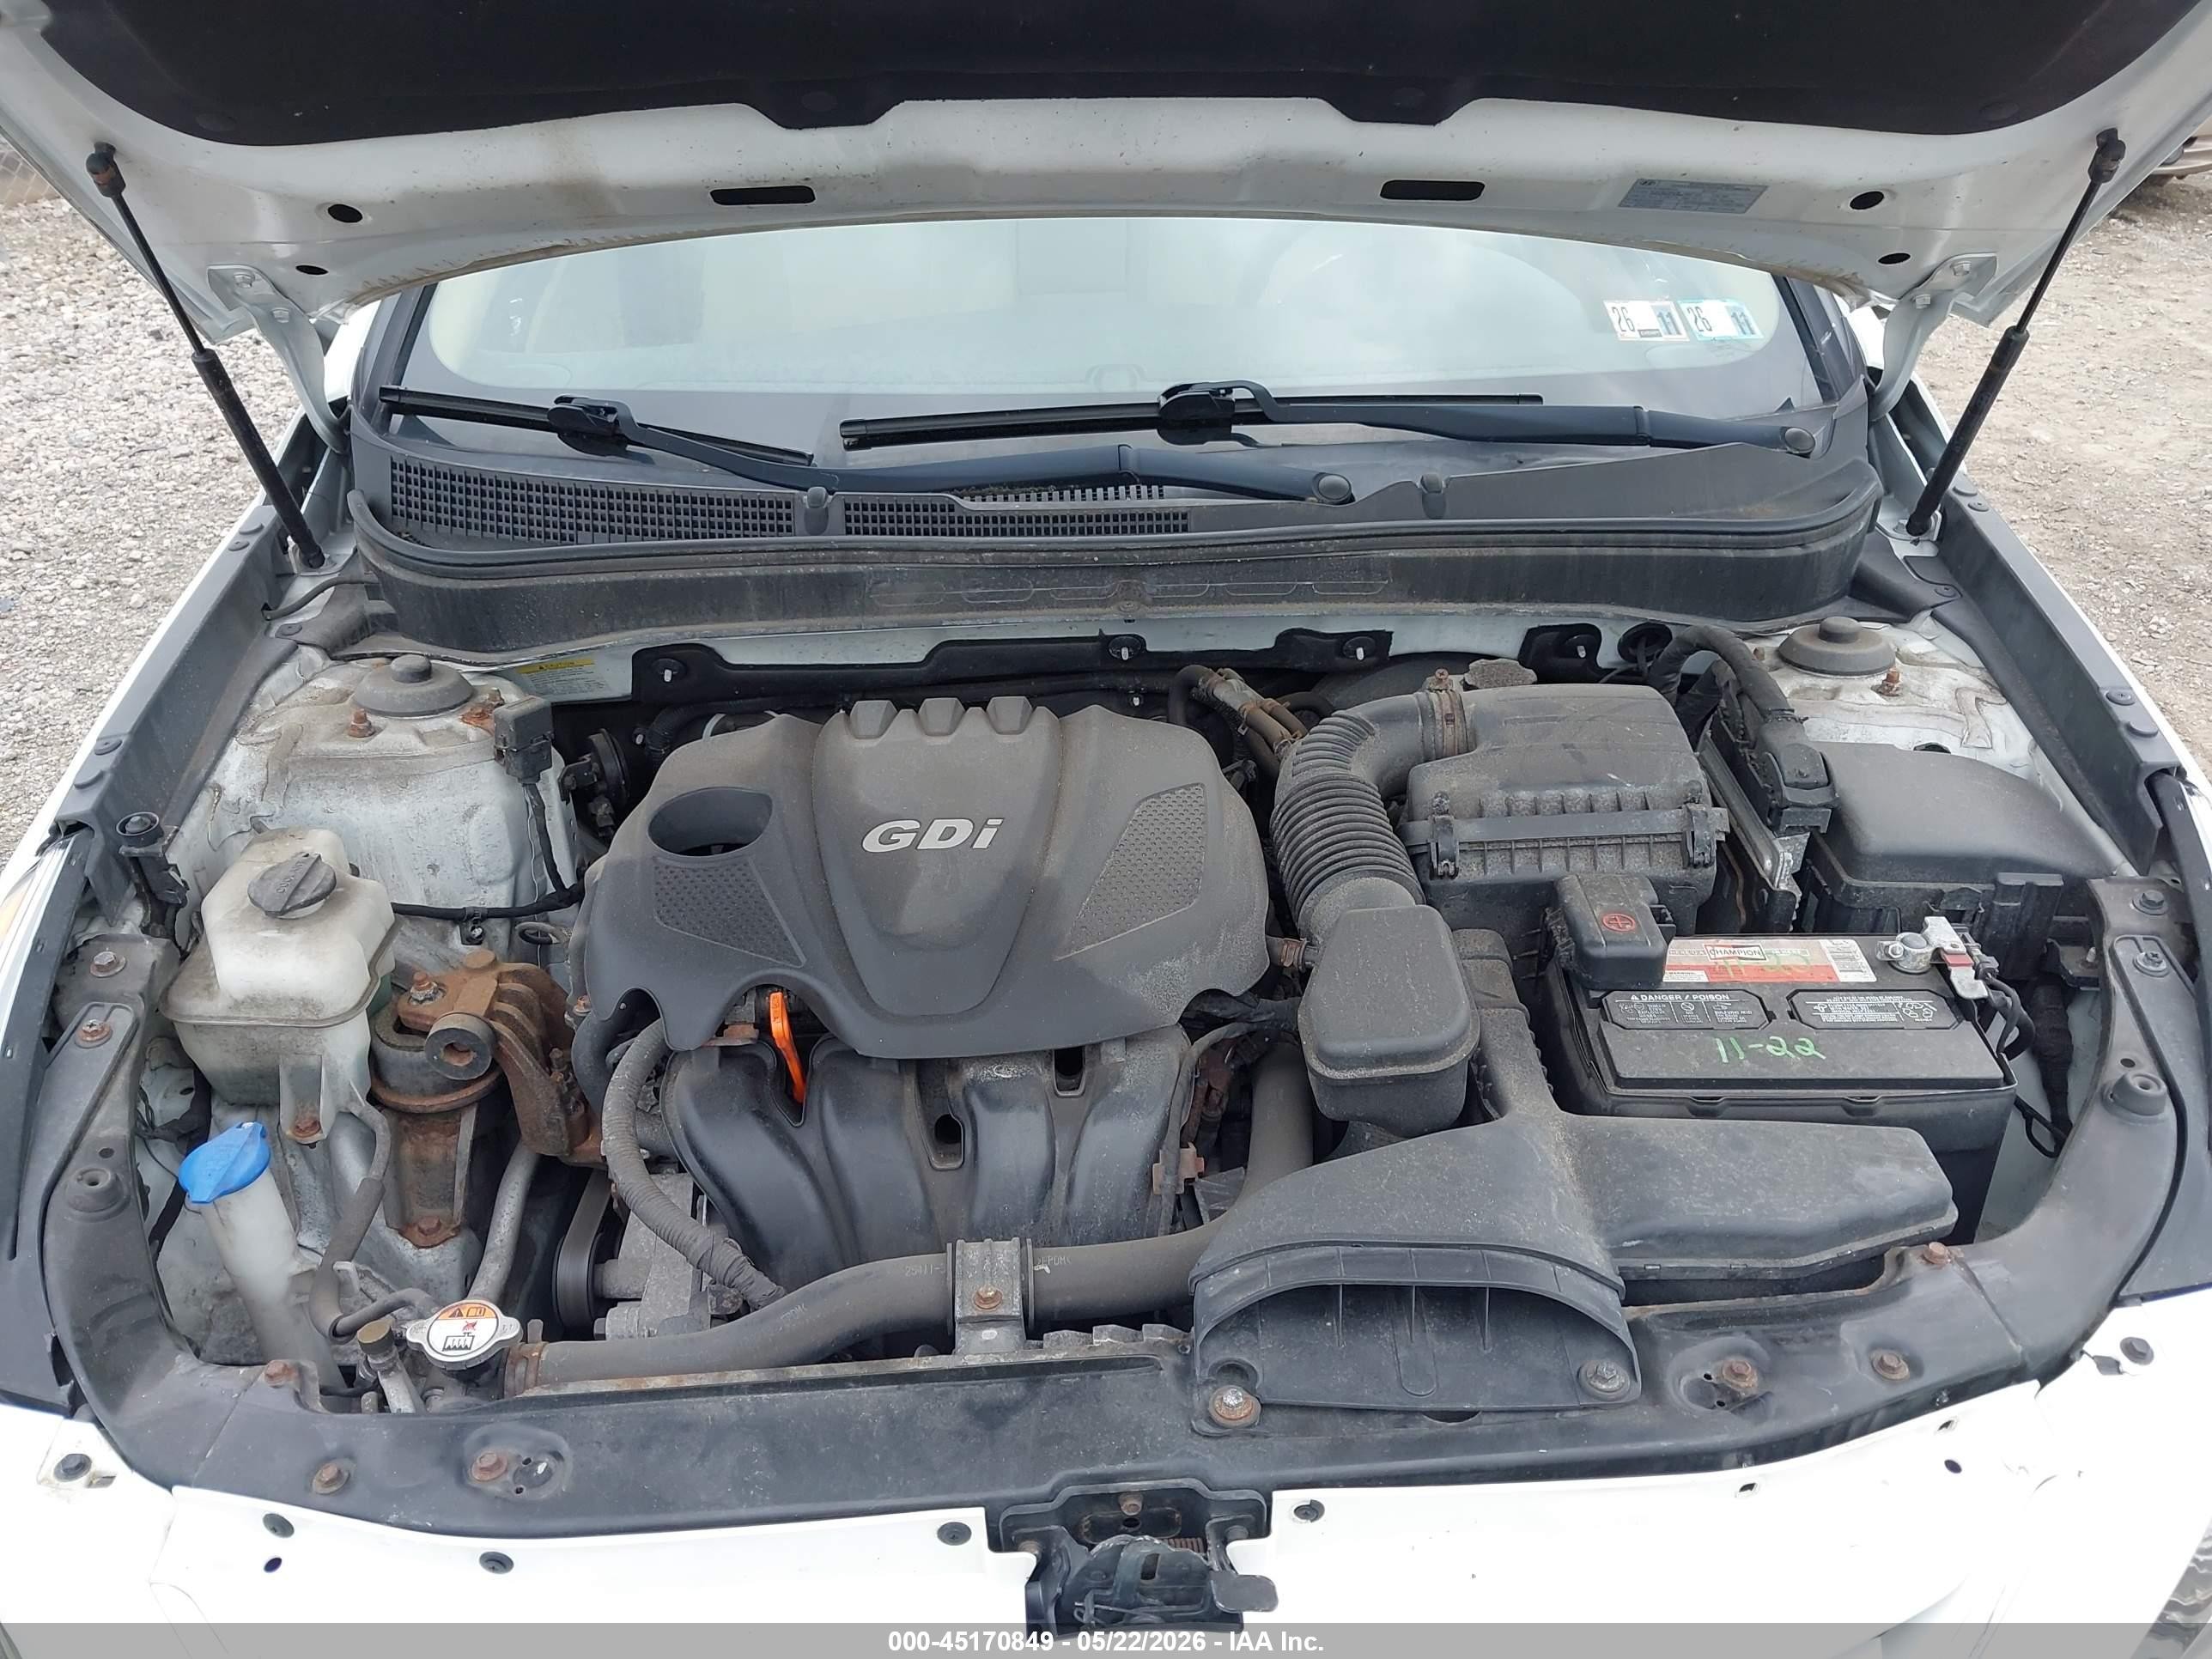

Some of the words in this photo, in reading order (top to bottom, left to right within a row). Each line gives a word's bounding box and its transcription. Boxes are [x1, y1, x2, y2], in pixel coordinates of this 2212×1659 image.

[1611, 306, 1635, 332] 26
[1657, 312, 1682, 335] 11
[1686, 306, 1712, 332] 26
[1730, 312, 1756, 335] 11
[860, 817, 1005, 853] GDi
[1709, 948, 1761, 957] CHAMPION
[1716, 1036, 1826, 1063] 11-22
